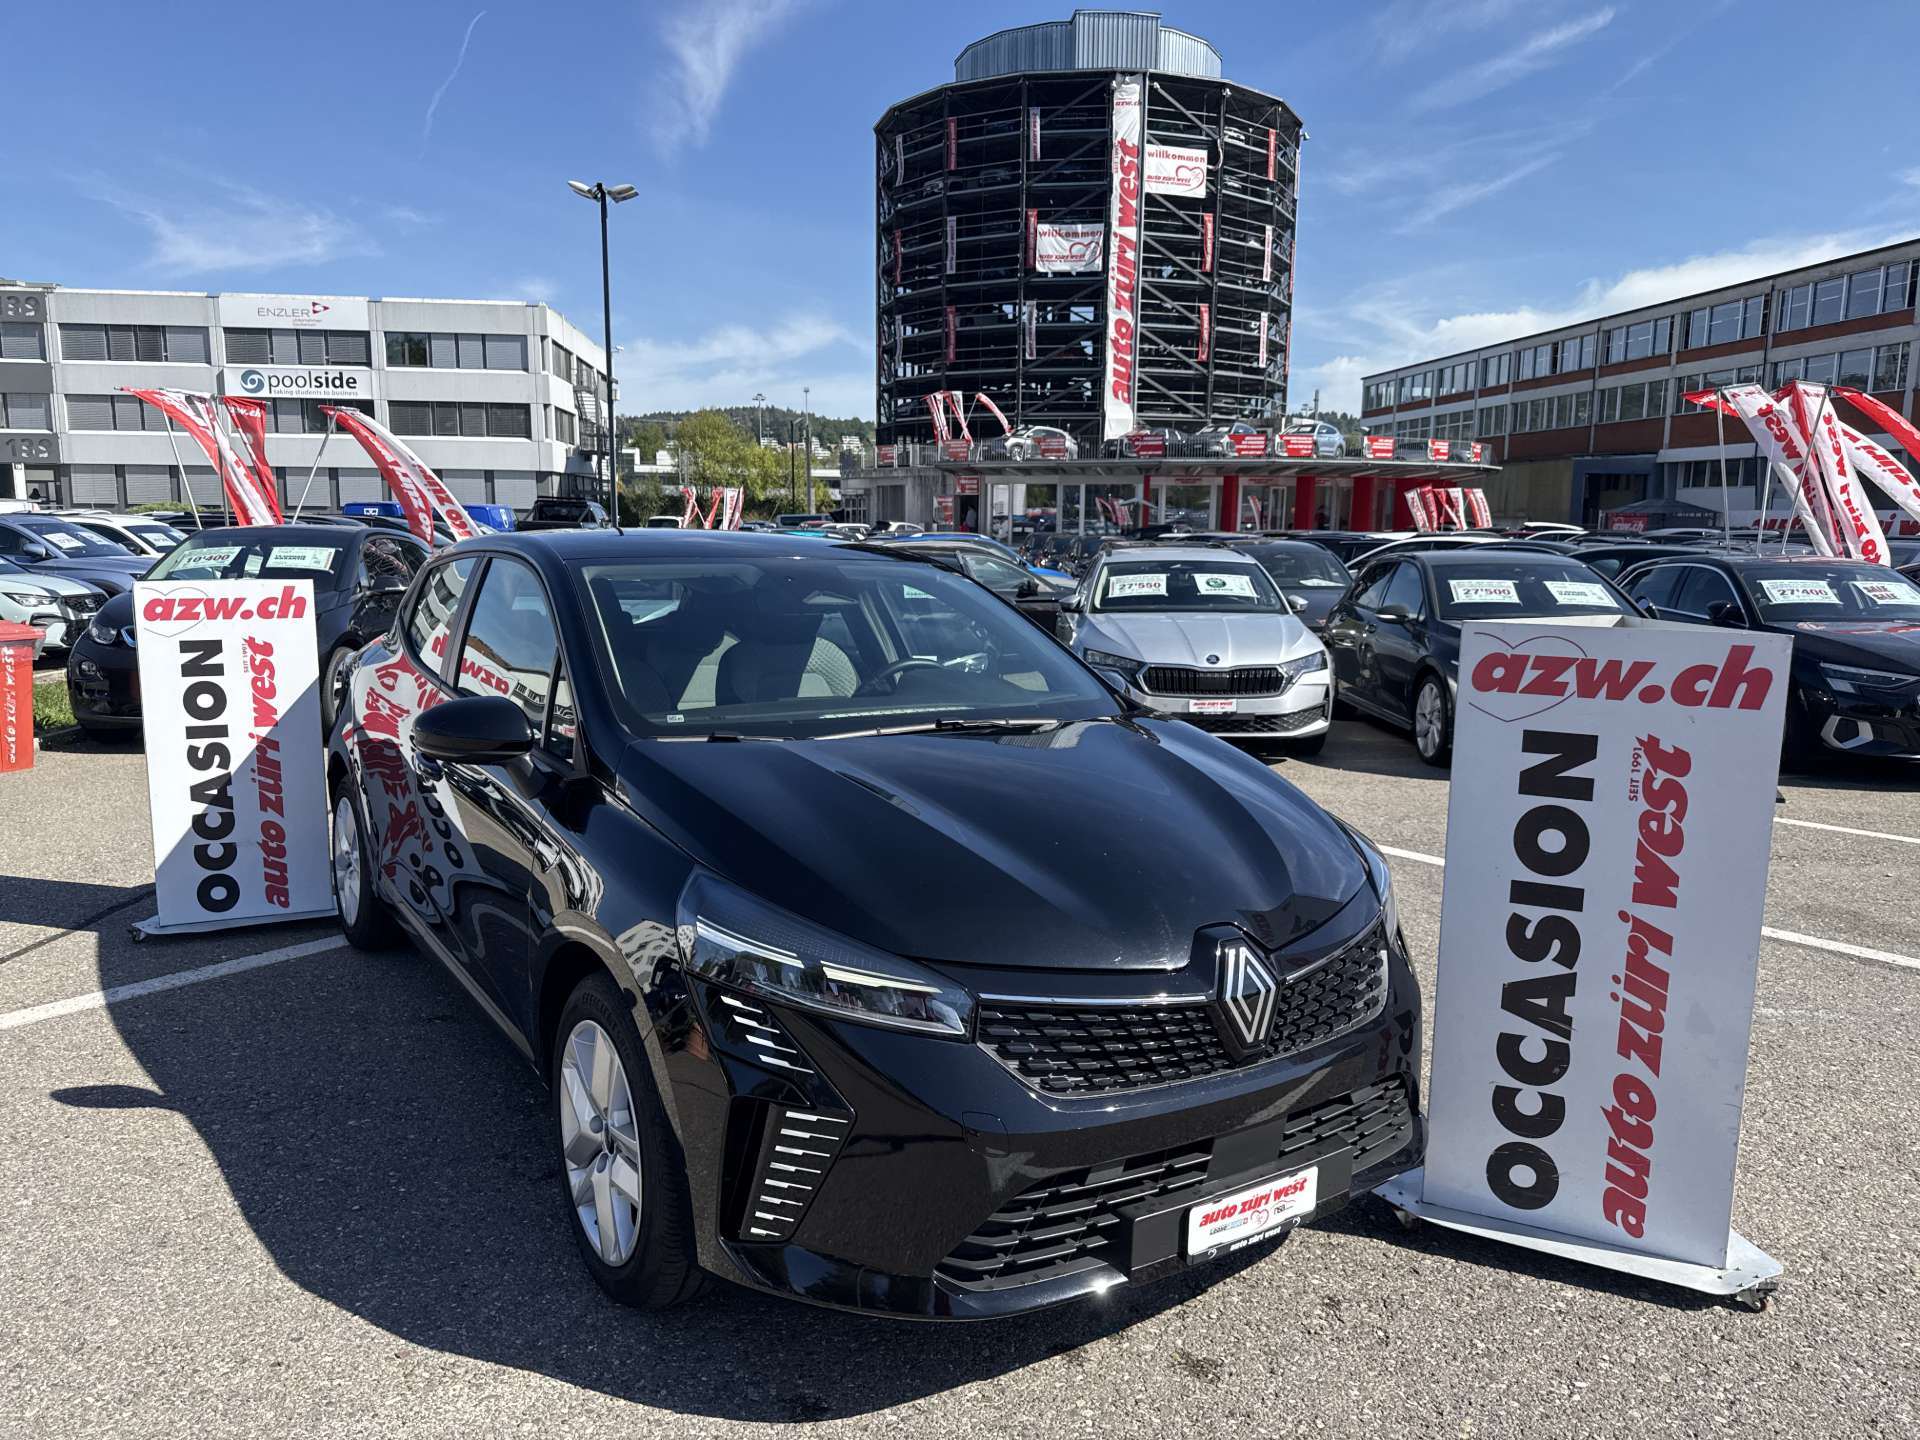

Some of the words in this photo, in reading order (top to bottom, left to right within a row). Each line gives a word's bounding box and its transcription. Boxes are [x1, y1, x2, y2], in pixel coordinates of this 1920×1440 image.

[1117, 138, 1141, 227] west
[1147, 149, 1206, 163] willkommen
[1039, 227, 1103, 238] willkommen
[1110, 231, 1136, 316] züri
[257, 307, 310, 318] ENZLER
[268, 371, 358, 394] poolside
[1110, 318, 1133, 404] auto
[186, 554, 230, 563] 10'400
[1118, 582, 1161, 591] 27'550
[143, 586, 307, 622] azw.ch
[1462, 587, 1511, 596] 27'500
[1777, 588, 1829, 596] 27'400
[243, 635, 279, 729] west
[1471, 644, 1774, 712] azw.ch
[178, 639, 241, 913] OCCASION
[248, 731, 286, 818] züri
[1631, 747, 1642, 773] 1991
[1629, 778, 1640, 802] SEIT
[1632, 733, 1692, 908] west
[260, 820, 291, 909] auto
[1486, 729, 1599, 1210] OCCASION
[1609, 909, 1675, 1079] züri
[1601, 1073, 1658, 1239] auto
[1199, 1203, 1238, 1228] auto
[1239, 1189, 1273, 1214] züri
[1273, 1177, 1308, 1202] west
